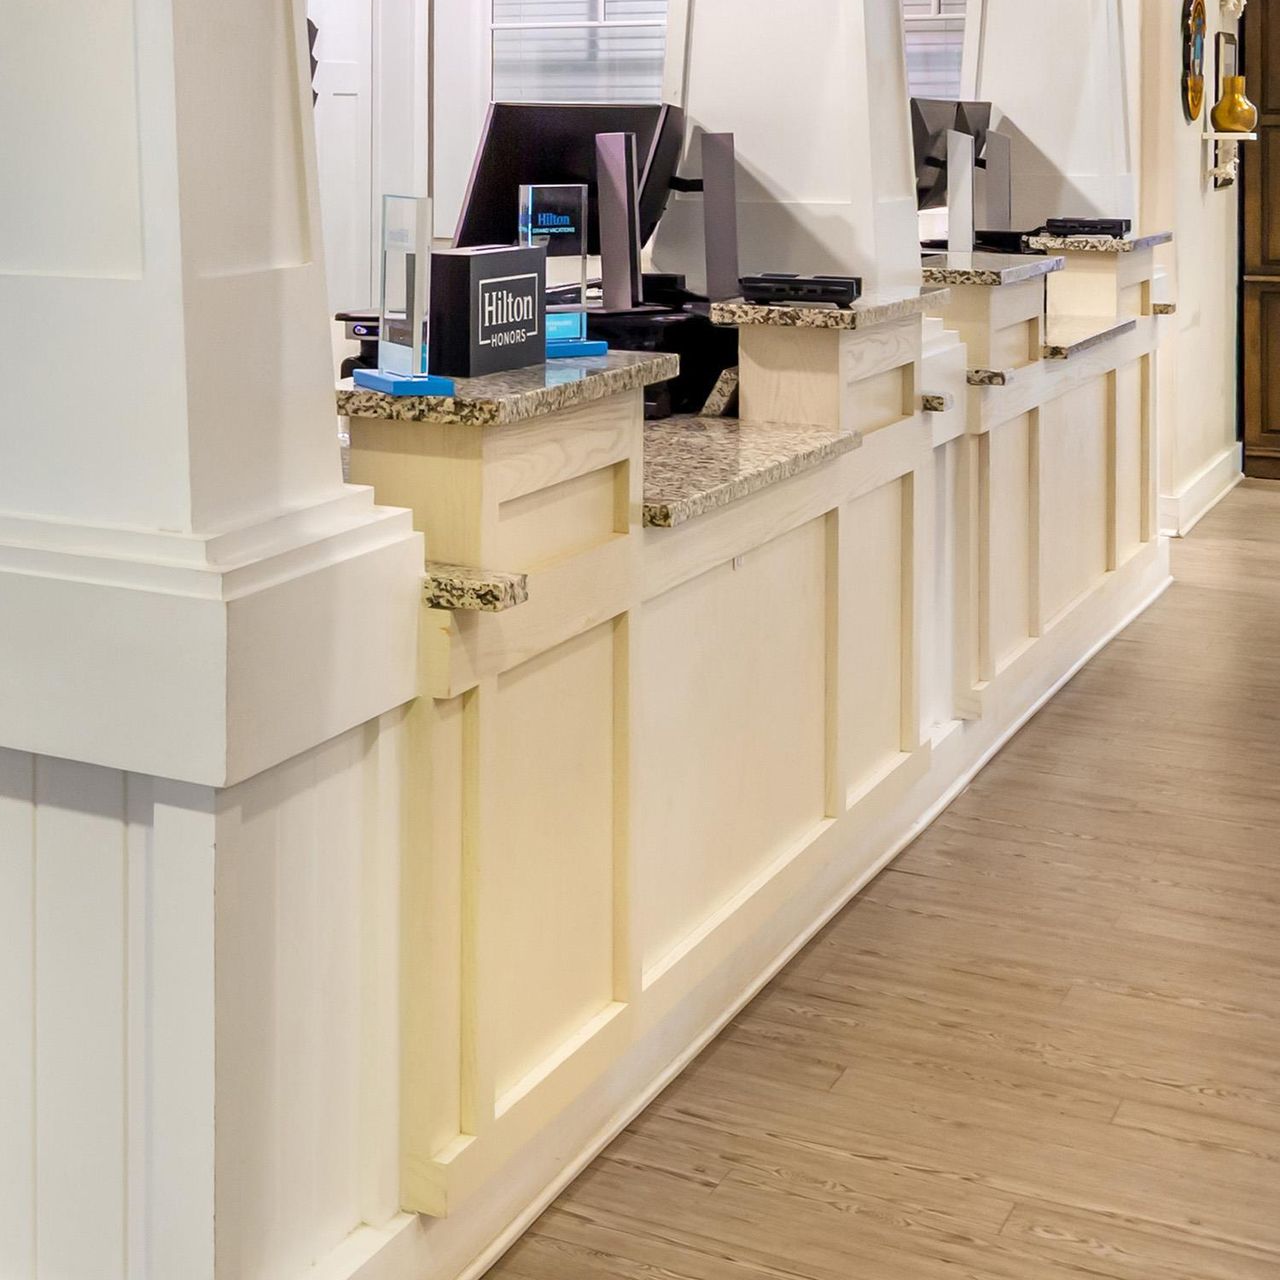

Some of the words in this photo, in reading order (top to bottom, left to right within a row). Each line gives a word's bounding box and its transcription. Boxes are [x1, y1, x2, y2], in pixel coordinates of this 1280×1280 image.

[538, 213, 570, 226] Hilton
[483, 290, 533, 327] Hilton
[491, 329, 527, 347] HONORS
